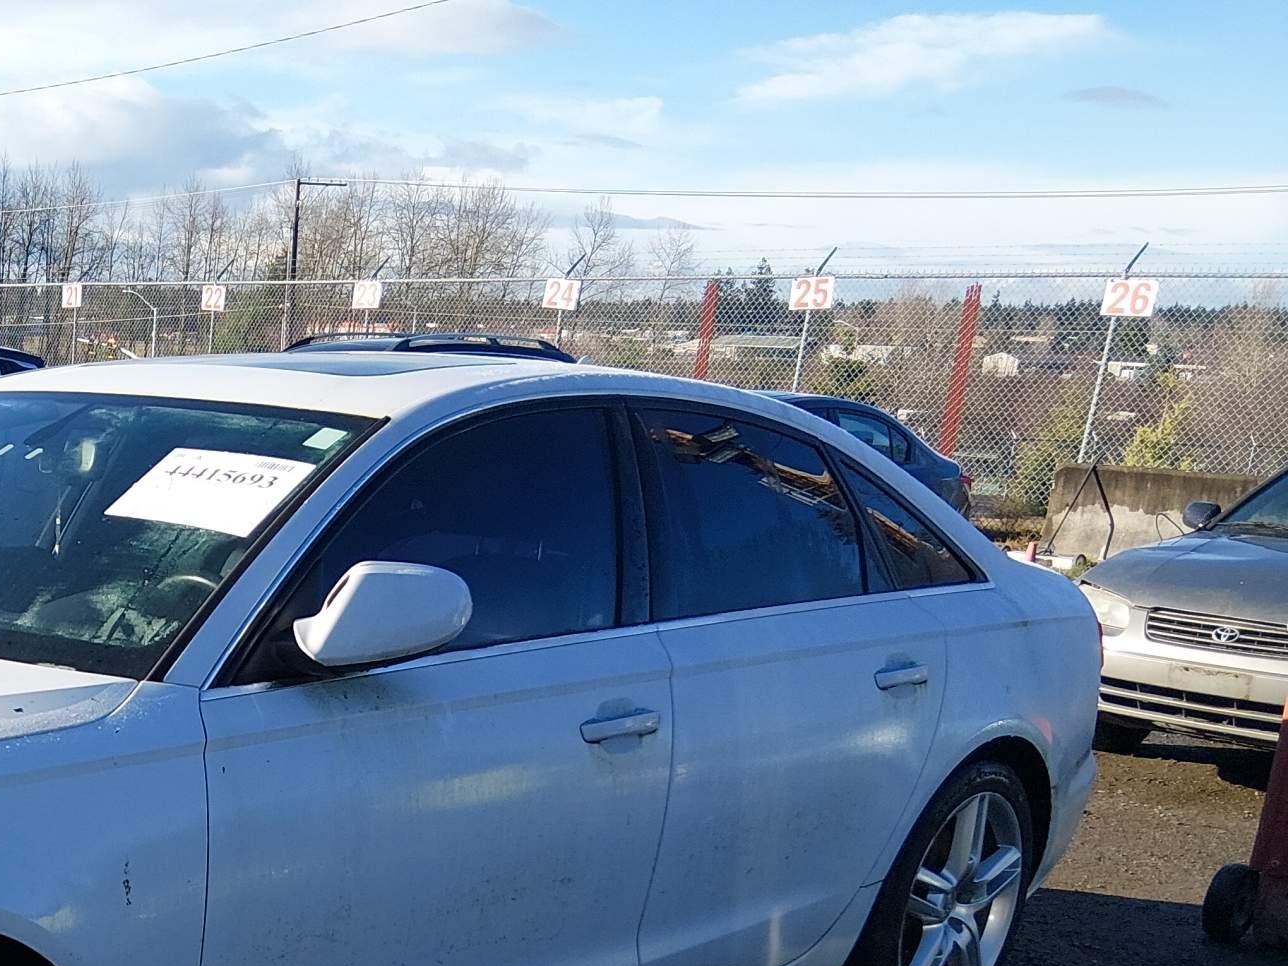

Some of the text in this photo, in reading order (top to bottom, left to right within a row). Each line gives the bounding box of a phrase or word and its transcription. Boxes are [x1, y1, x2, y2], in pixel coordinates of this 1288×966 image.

[66, 286, 79, 306] 21
[204, 287, 223, 310] 22
[356, 283, 378, 307] 23
[546, 281, 575, 307] 24
[793, 278, 829, 308] 25
[1106, 282, 1151, 315] 26
[165, 464, 279, 489] 44415693
